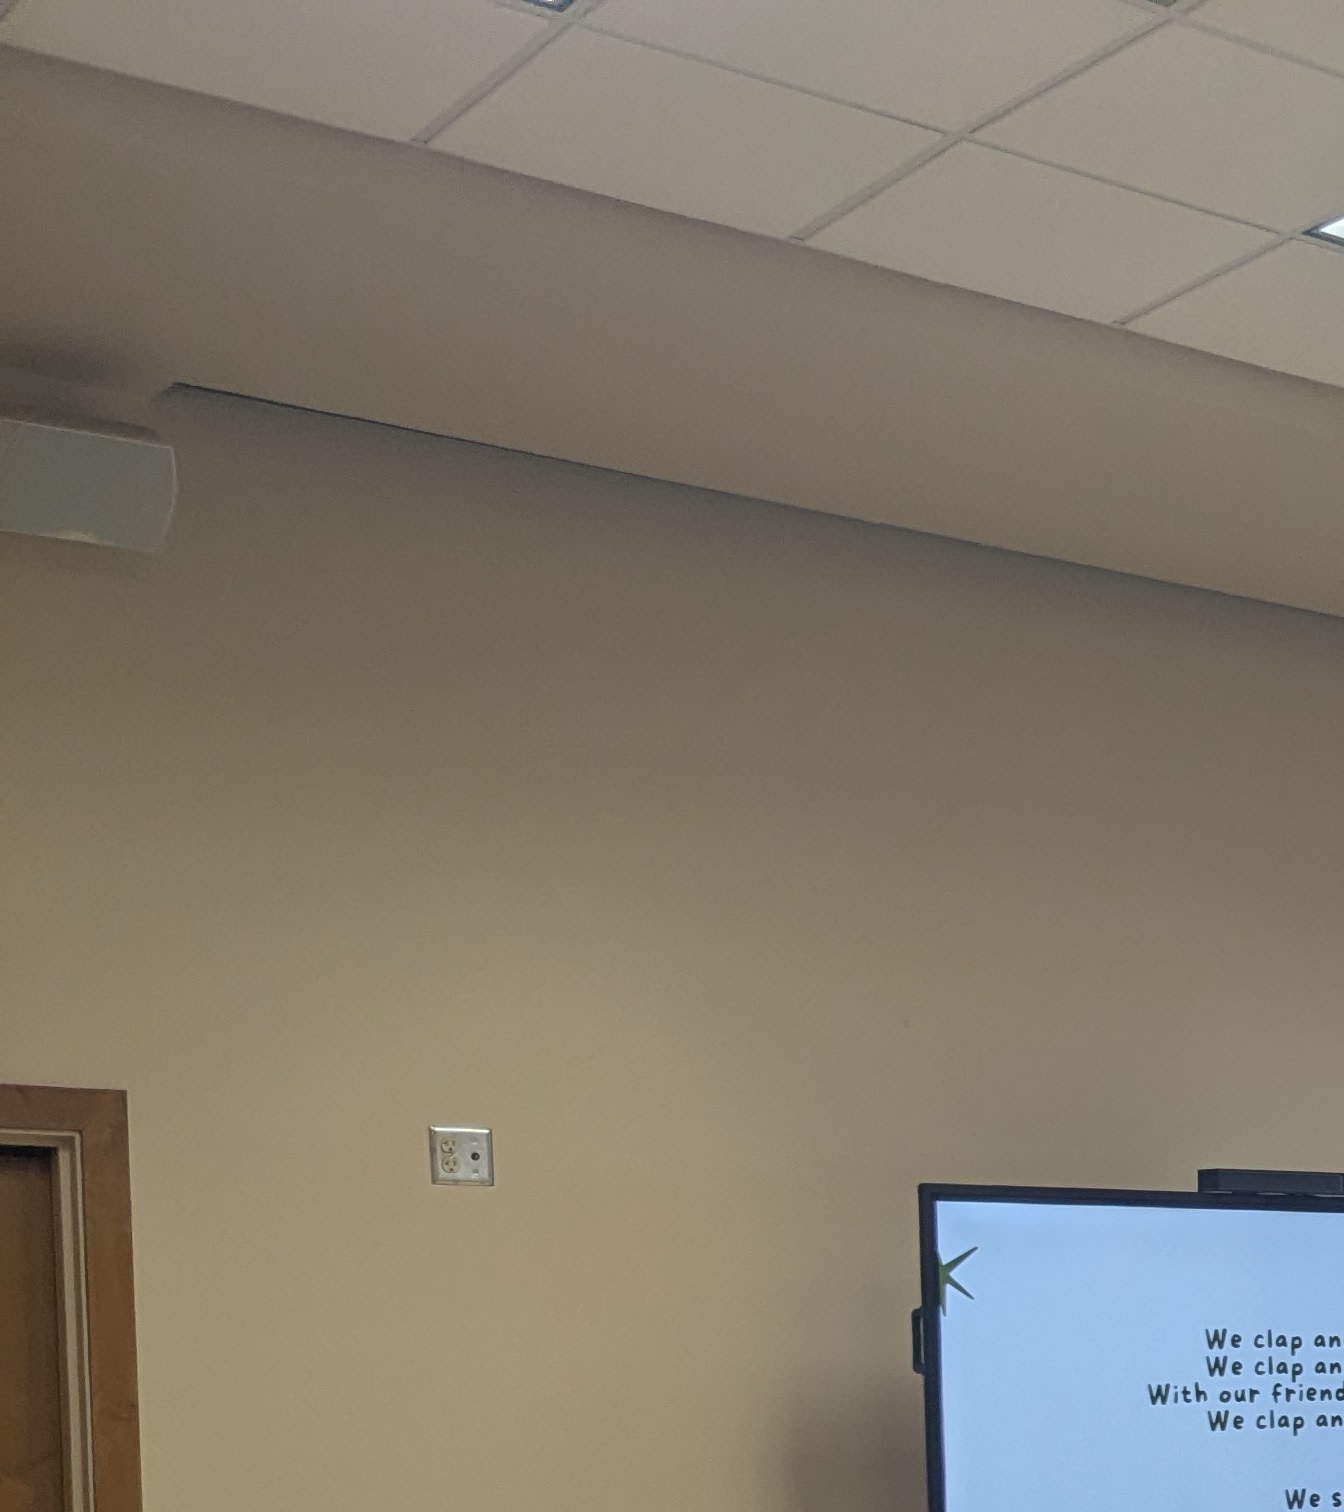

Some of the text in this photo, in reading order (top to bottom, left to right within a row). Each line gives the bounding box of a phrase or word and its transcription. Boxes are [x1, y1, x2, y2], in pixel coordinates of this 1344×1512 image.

[1205, 1328, 1242, 1350] We
[1253, 1329, 1303, 1356] clap
[1205, 1355, 1243, 1377] We
[1254, 1356, 1304, 1383] clap
[1148, 1382, 1208, 1405] With
[1219, 1387, 1260, 1403] our
[1208, 1409, 1245, 1431] We
[1256, 1409, 1305, 1437] clap
[1285, 1488, 1321, 1510] We
